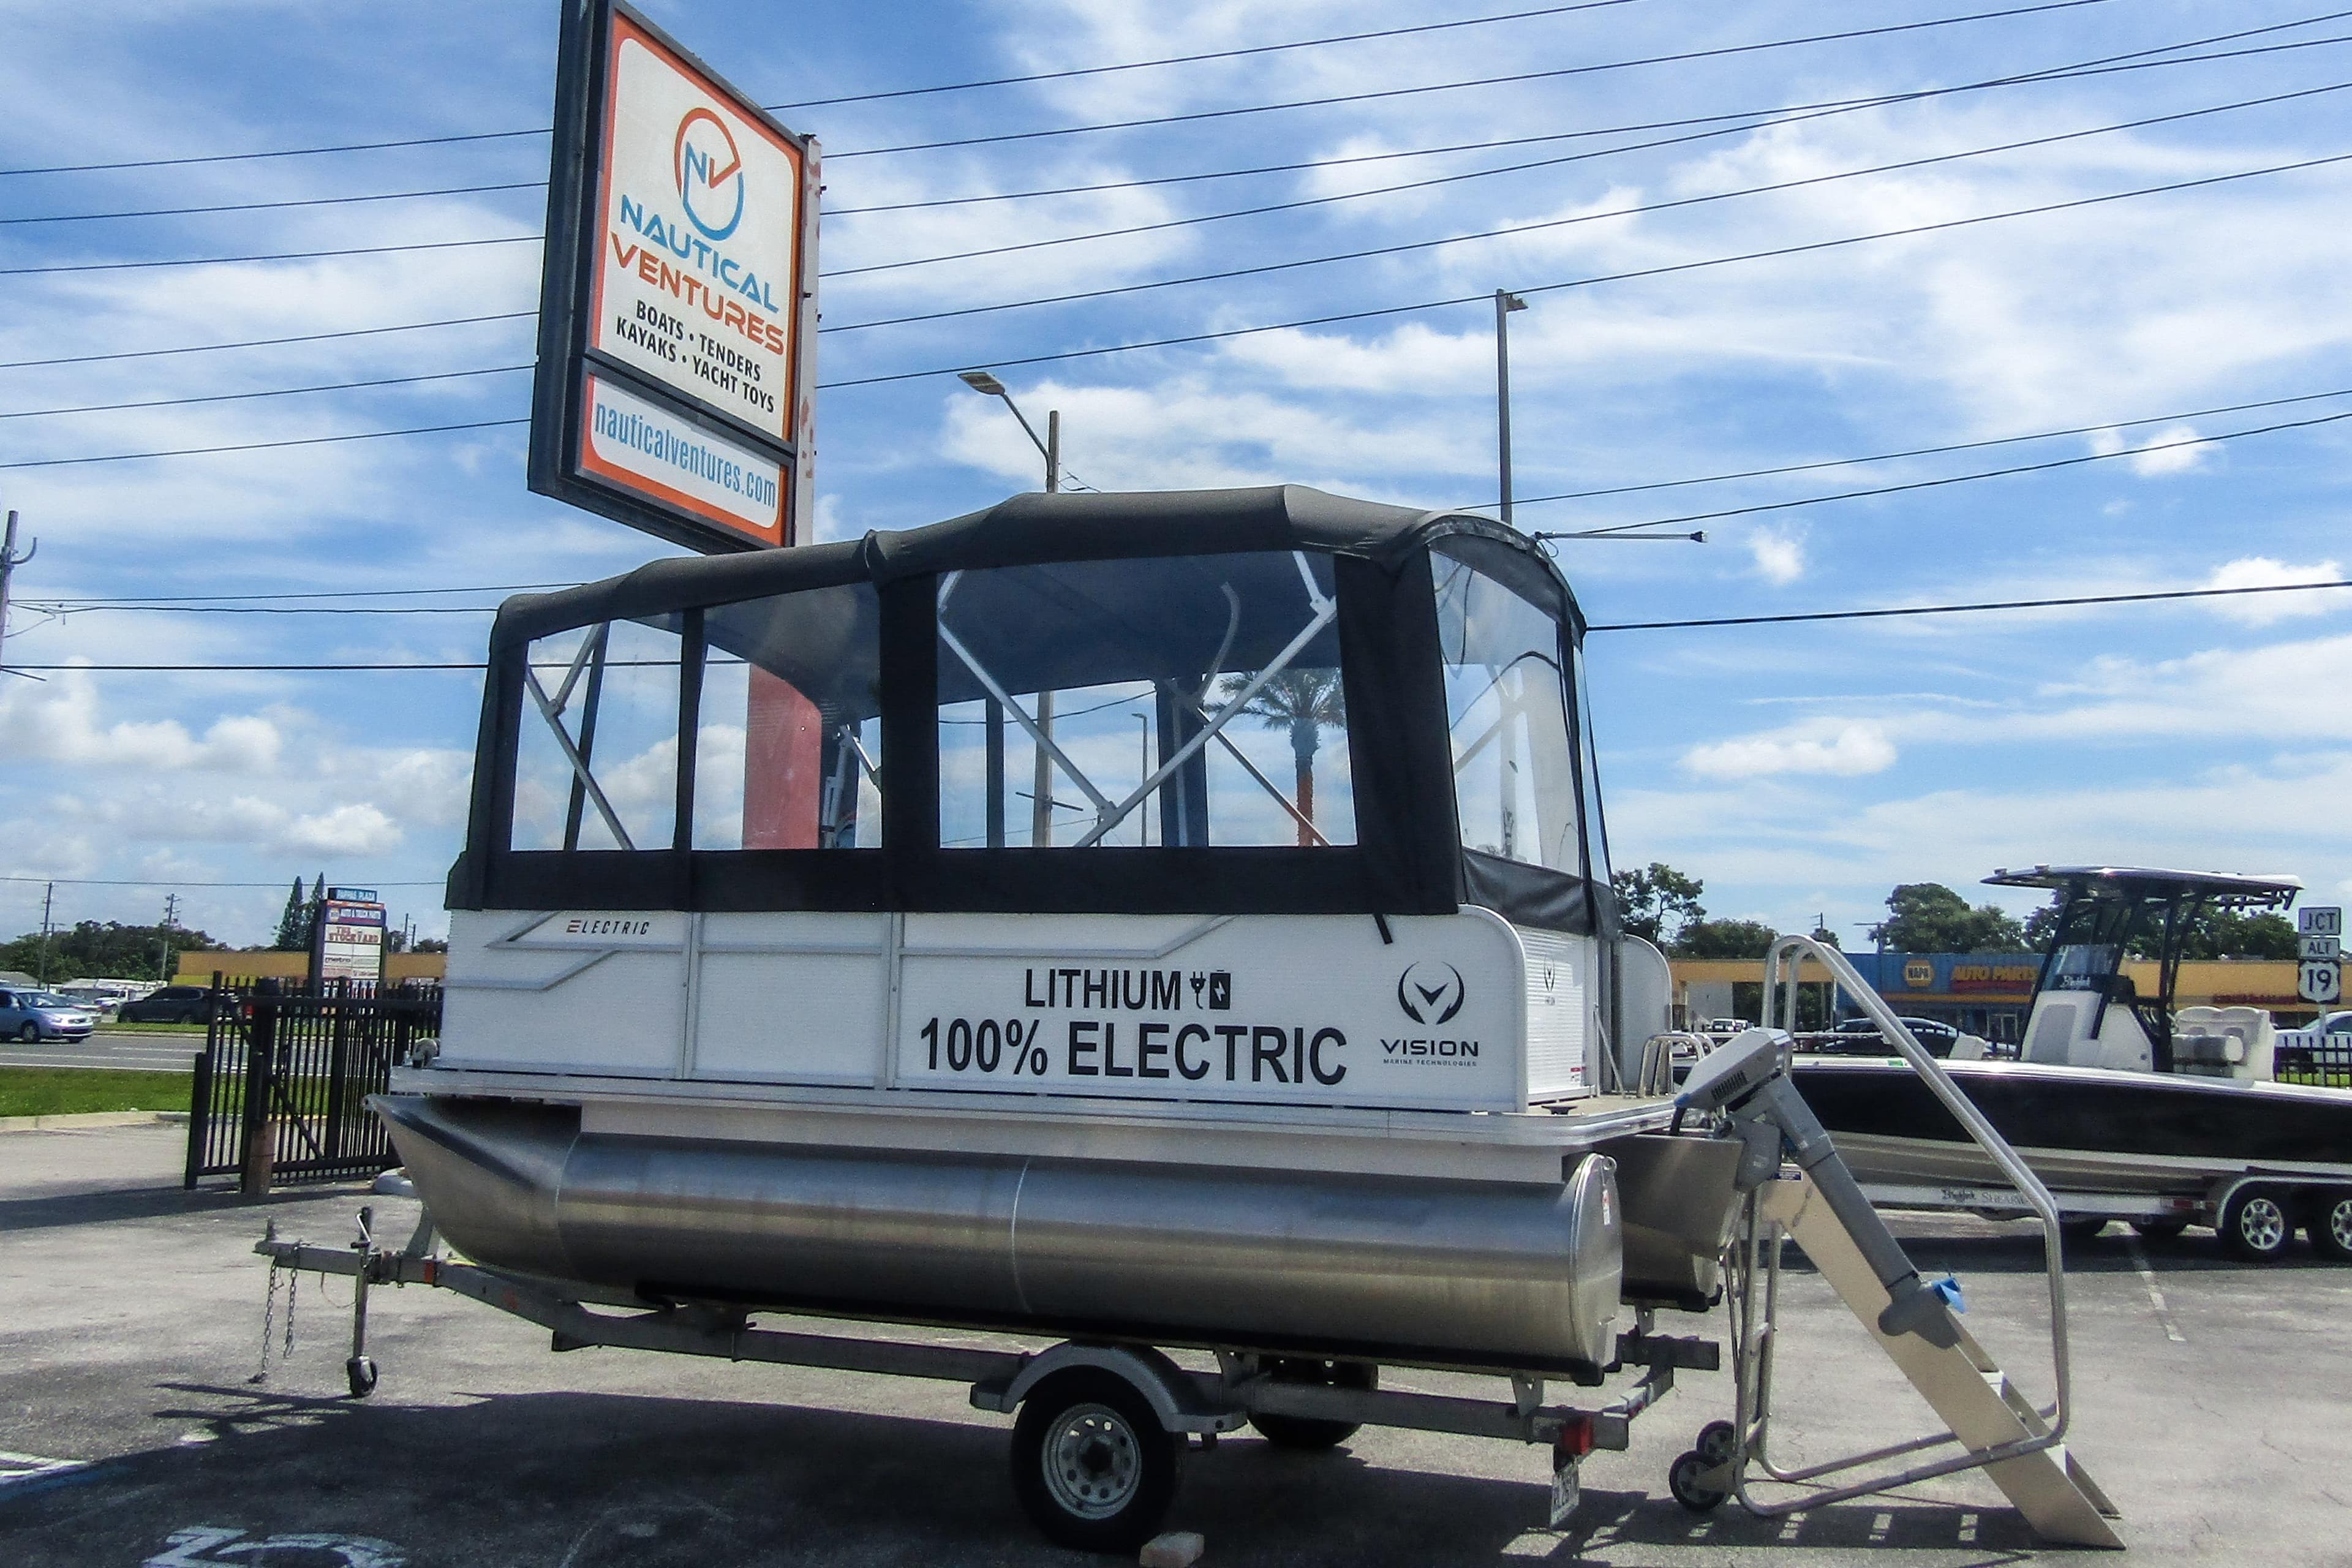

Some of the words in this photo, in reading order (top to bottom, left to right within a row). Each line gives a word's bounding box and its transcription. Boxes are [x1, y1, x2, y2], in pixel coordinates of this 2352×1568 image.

[620, 194, 778, 314] NAUTICAL
[611, 231, 784, 355] VENTURES
[636, 300, 684, 341] BOATS
[699, 333, 761, 382] TENDERS
[616, 315, 676, 363] KAYAKS
[692, 355, 737, 394] YACHT
[742, 382, 774, 413] TOYS
[595, 402, 775, 508] nauticalventures.com
[566, 920, 650, 935] ELECTRIC
[2304, 913, 2335, 930] JCT
[2308, 942, 2331, 955] ALT
[1907, 967, 1929, 979] NAPA
[1951, 965, 1991, 981] AUTO
[2307, 969, 2332, 993] 19
[1025, 969, 1180, 1010] LITHIUM
[920, 1017, 1047, 1076] 100%
[1068, 1021, 1348, 1085] ELECTRIC
[1380, 1039, 1479, 1057] VISION
